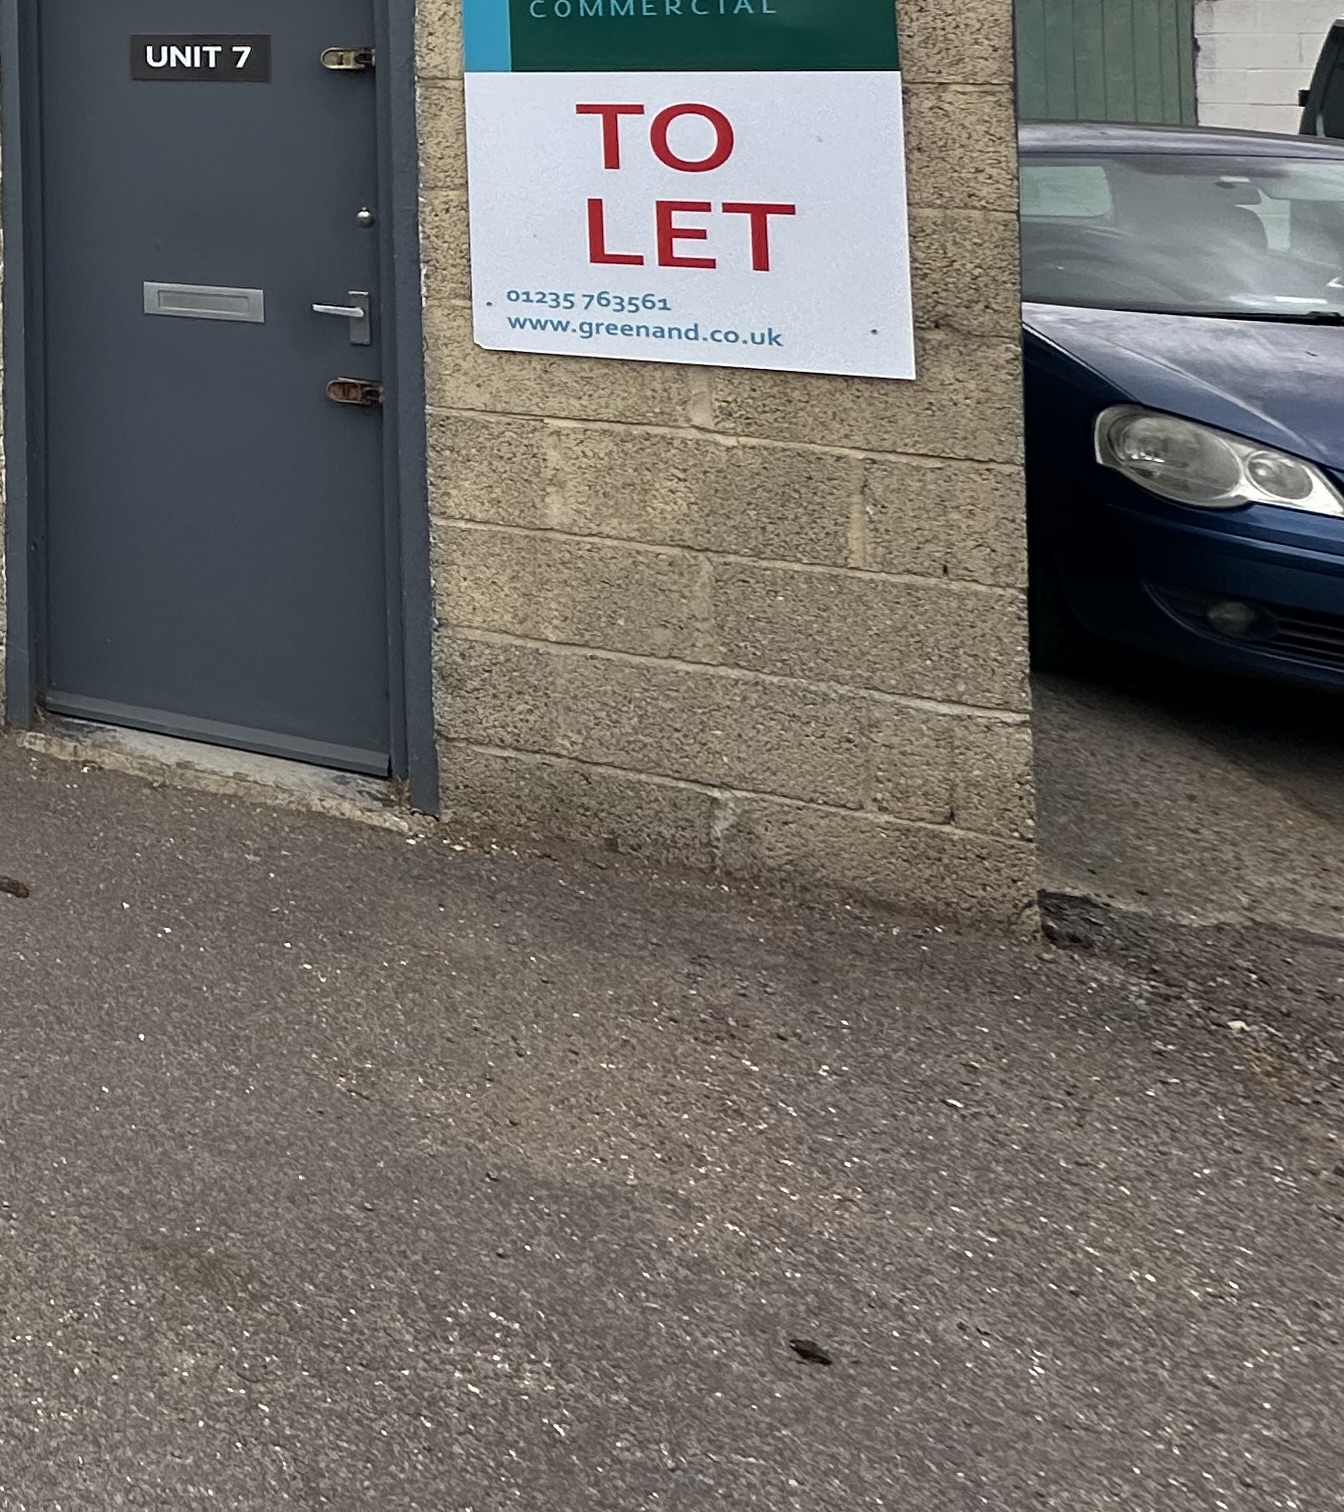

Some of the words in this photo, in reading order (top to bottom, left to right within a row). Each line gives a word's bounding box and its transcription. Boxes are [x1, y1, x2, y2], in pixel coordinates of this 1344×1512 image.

[146, 45, 223, 68] UNIT
[232, 46, 253, 69] 7
[575, 102, 735, 173] TO
[586, 198, 797, 272] LET
[506, 289, 575, 309] 01235
[581, 290, 672, 314] 763561
[506, 315, 784, 348] www.greenand.co.uk
